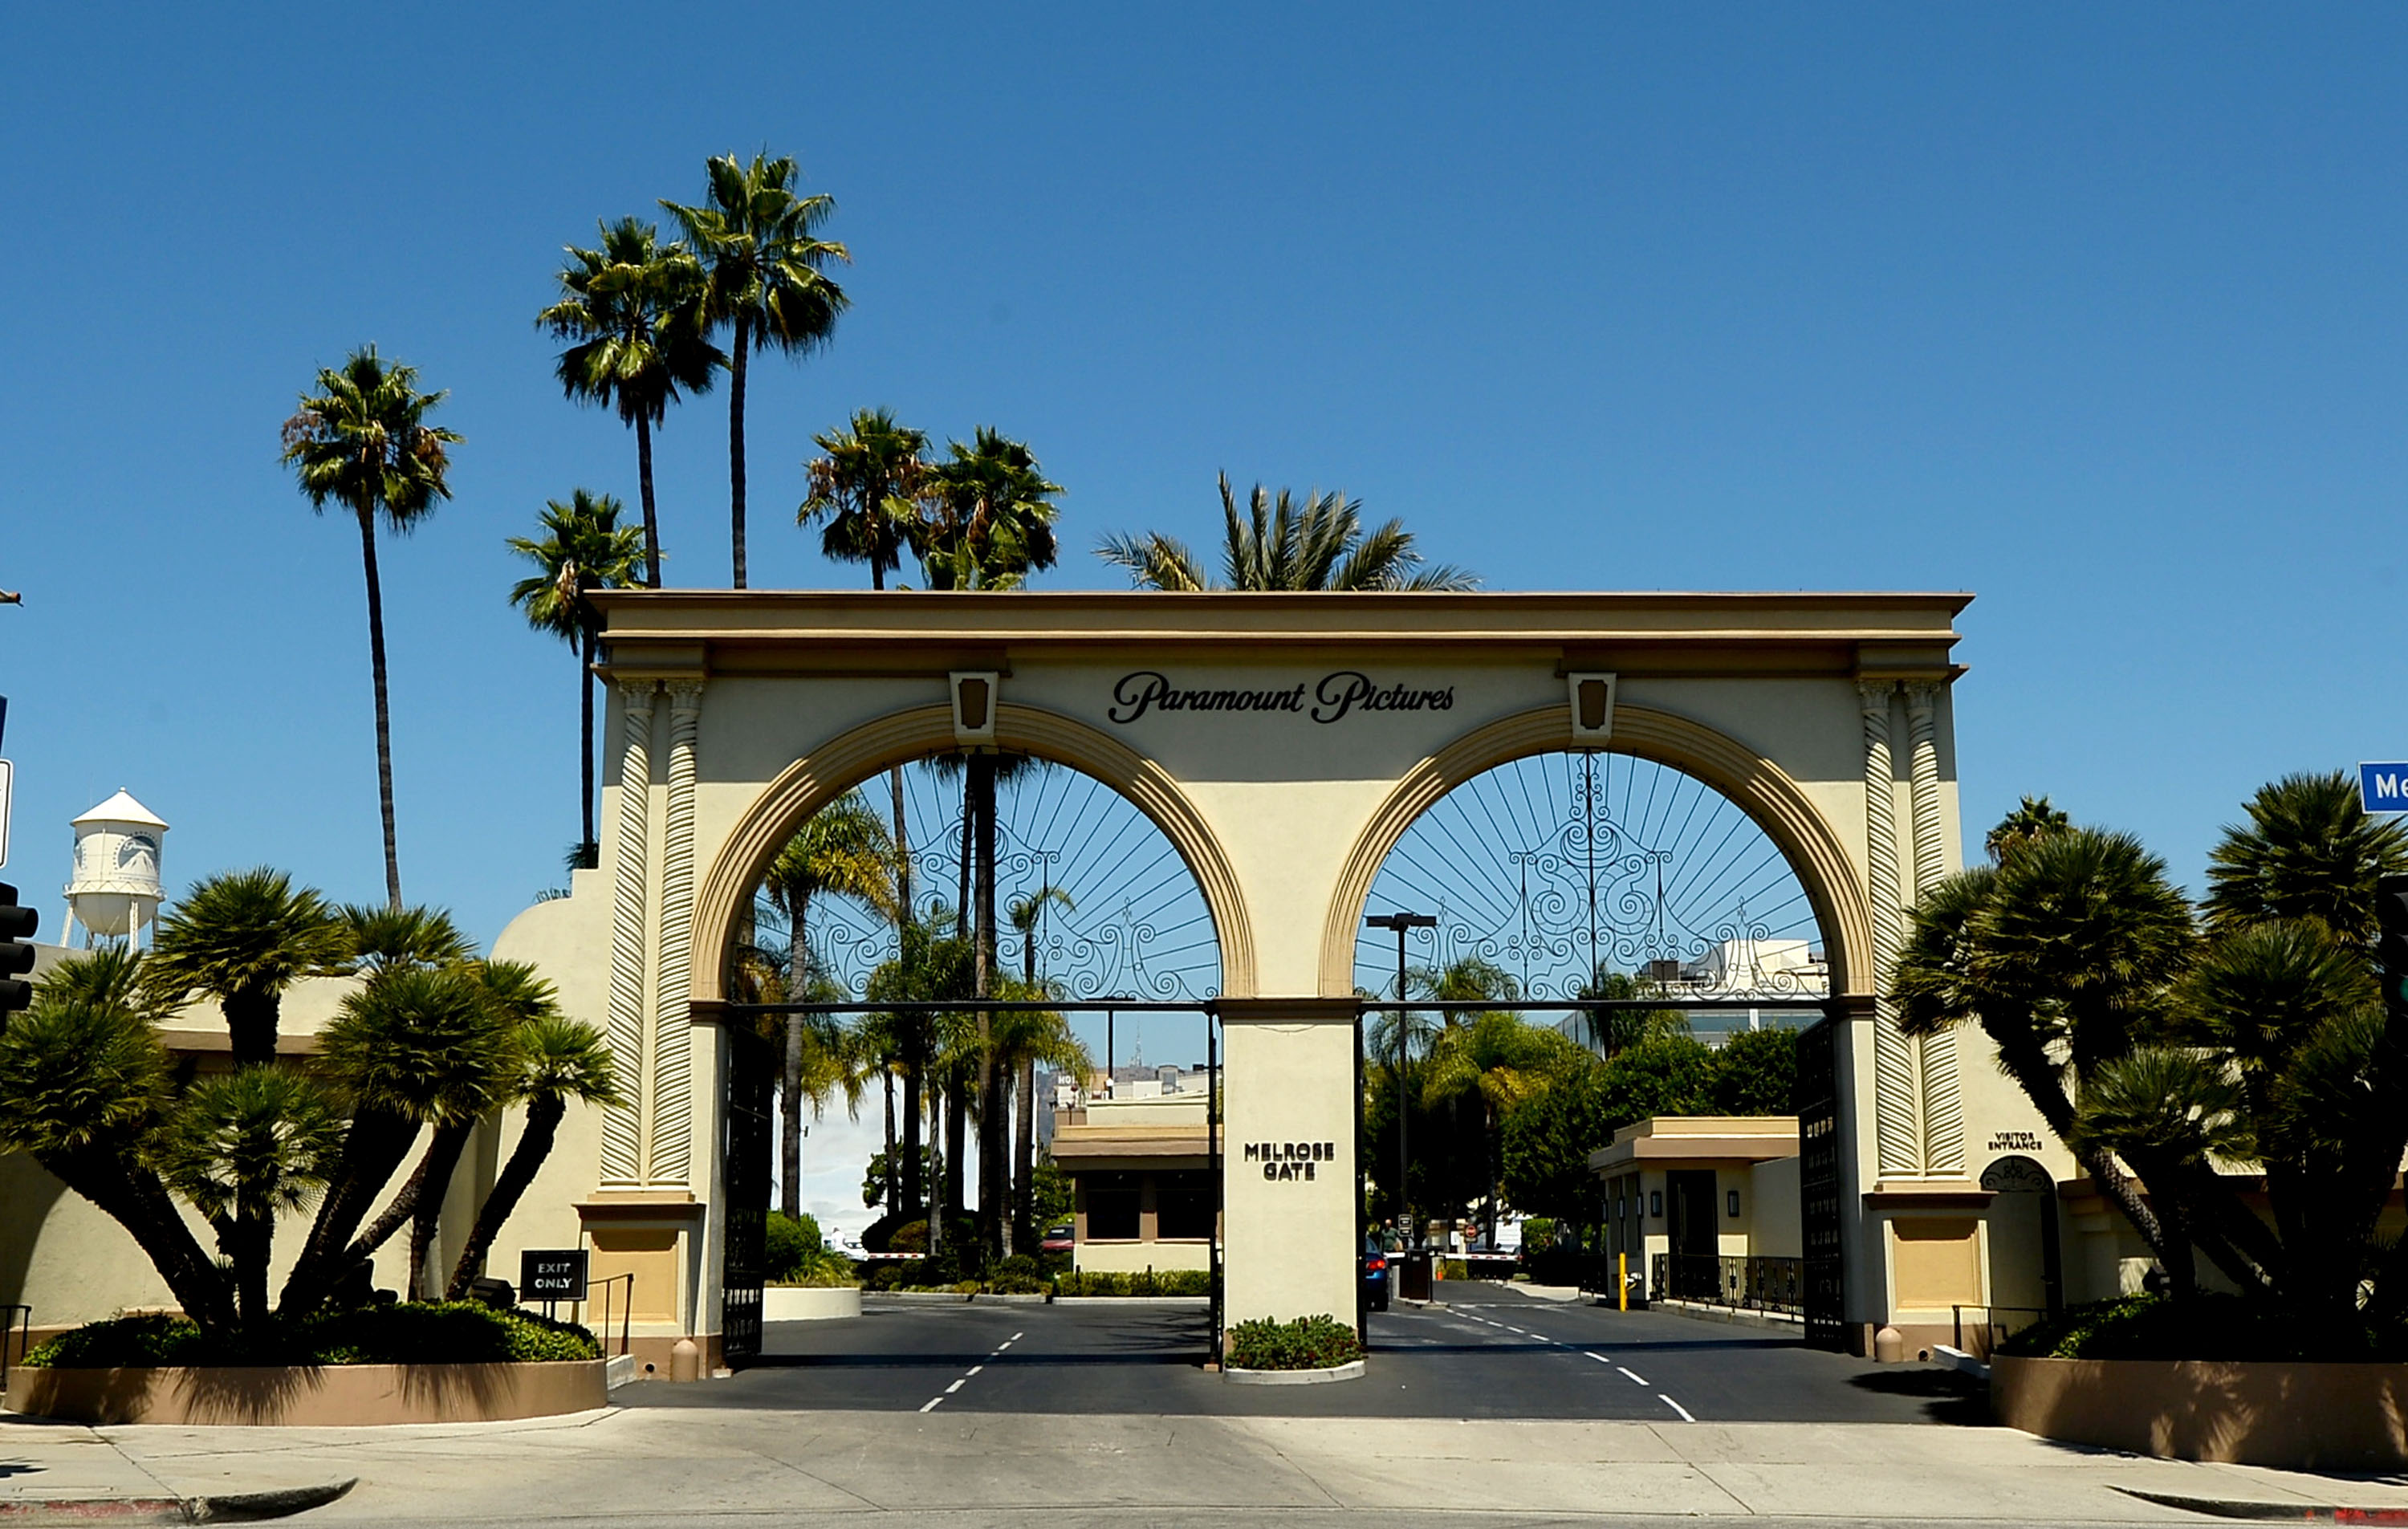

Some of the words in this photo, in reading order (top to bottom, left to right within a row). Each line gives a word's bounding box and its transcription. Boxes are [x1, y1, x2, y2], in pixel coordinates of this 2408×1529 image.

[1108, 671, 1305, 724] Paramount
[1311, 671, 1454, 724] Pictures
[2375, 773, 2408, 799] Me
[1995, 1132, 2034, 1141] VISITOR
[1244, 1142, 1334, 1162] MELROSE
[1987, 1141, 2043, 1150] ENTRANCE
[1263, 1162, 1315, 1181] GATE
[538, 1263, 571, 1274] EXIT
[535, 1278, 572, 1289] ONLY
